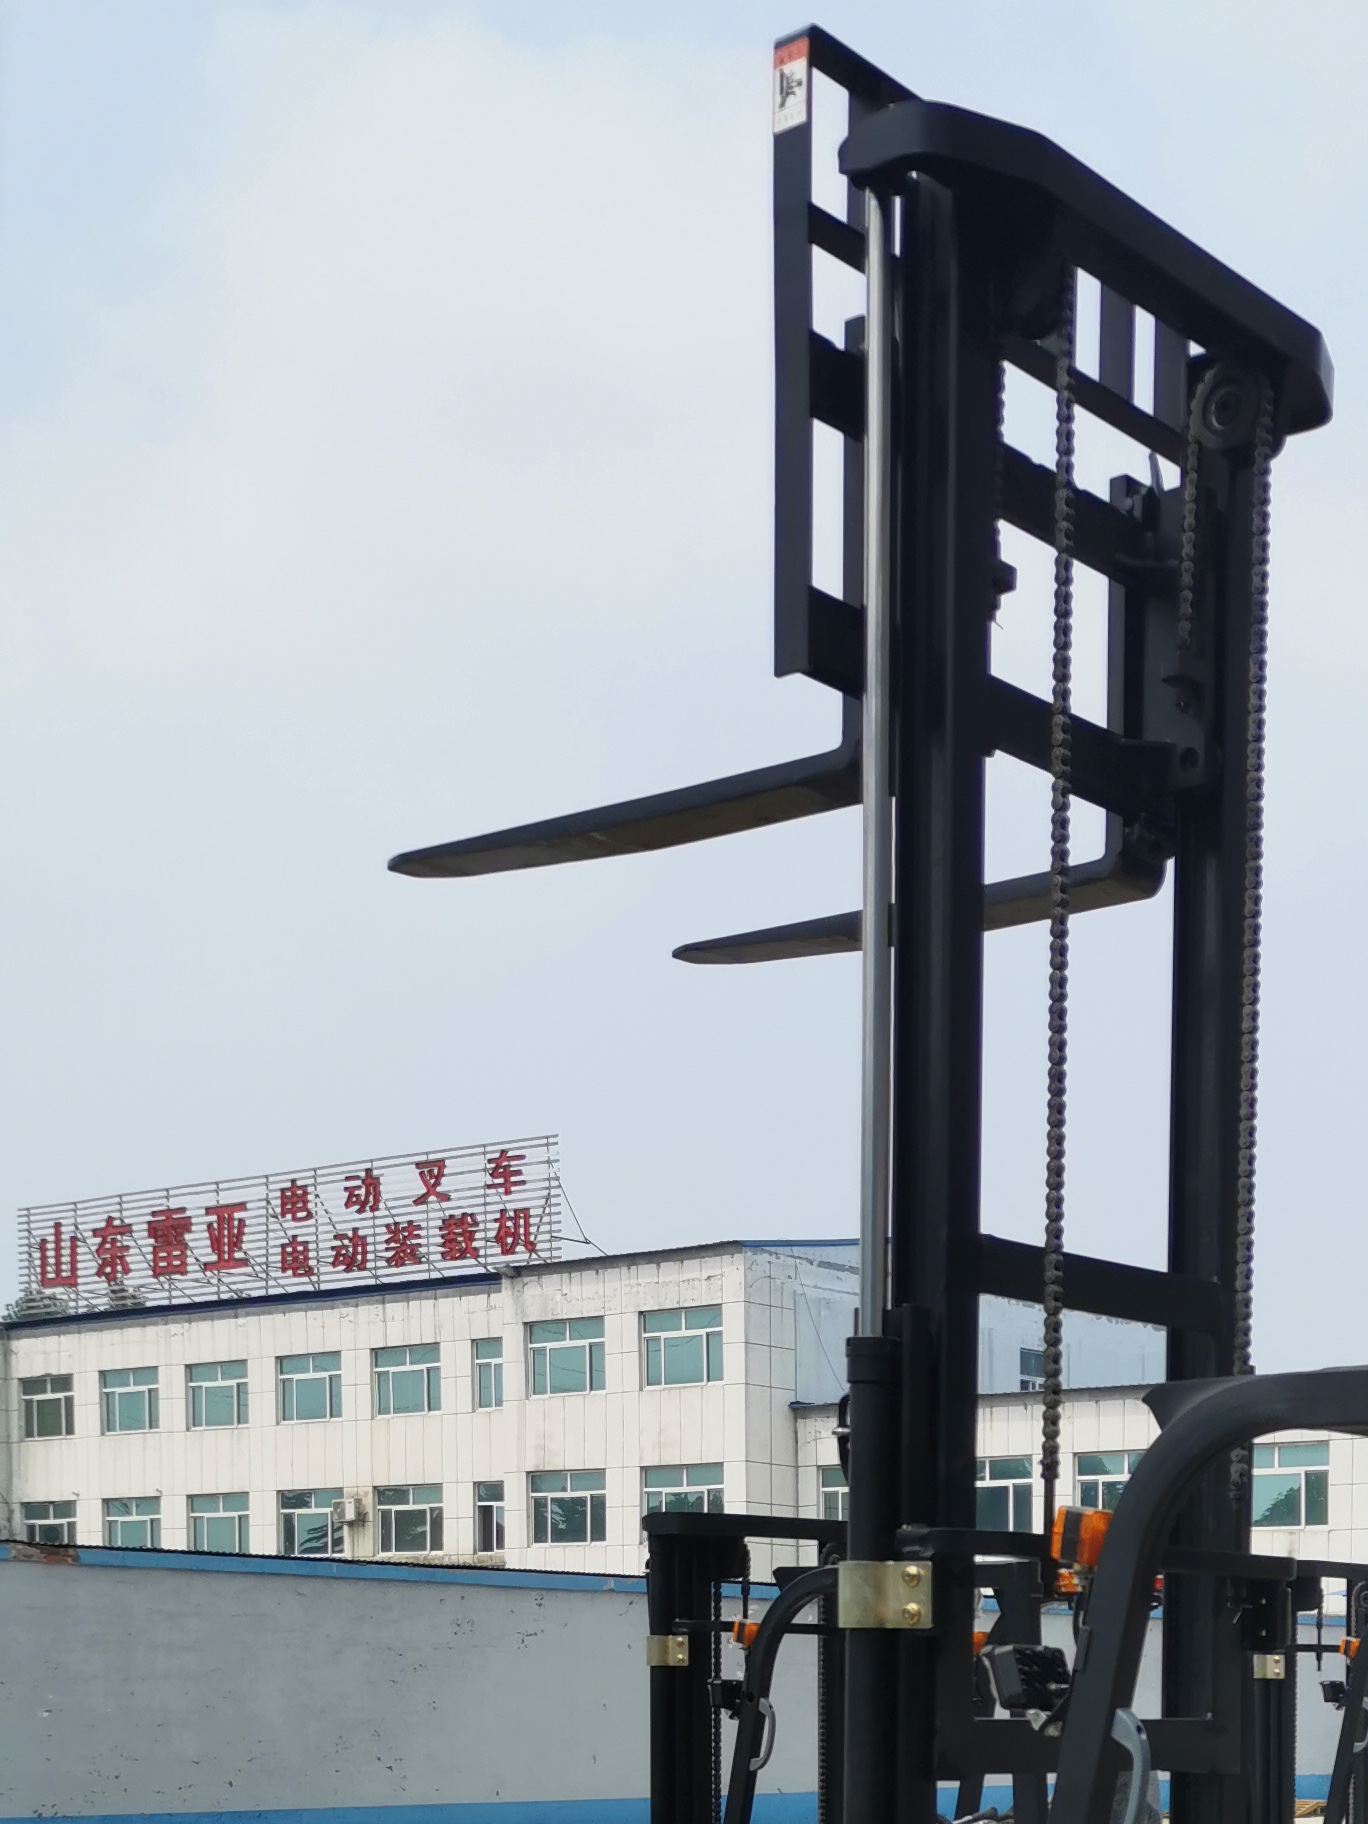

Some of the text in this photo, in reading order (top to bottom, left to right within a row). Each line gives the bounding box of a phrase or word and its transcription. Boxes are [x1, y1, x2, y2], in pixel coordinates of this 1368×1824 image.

[280, 1150, 526, 1223] 电动叉车
[40, 1202, 249, 1288] 山东雷亚
[280, 1208, 537, 1278] 电动装载机
